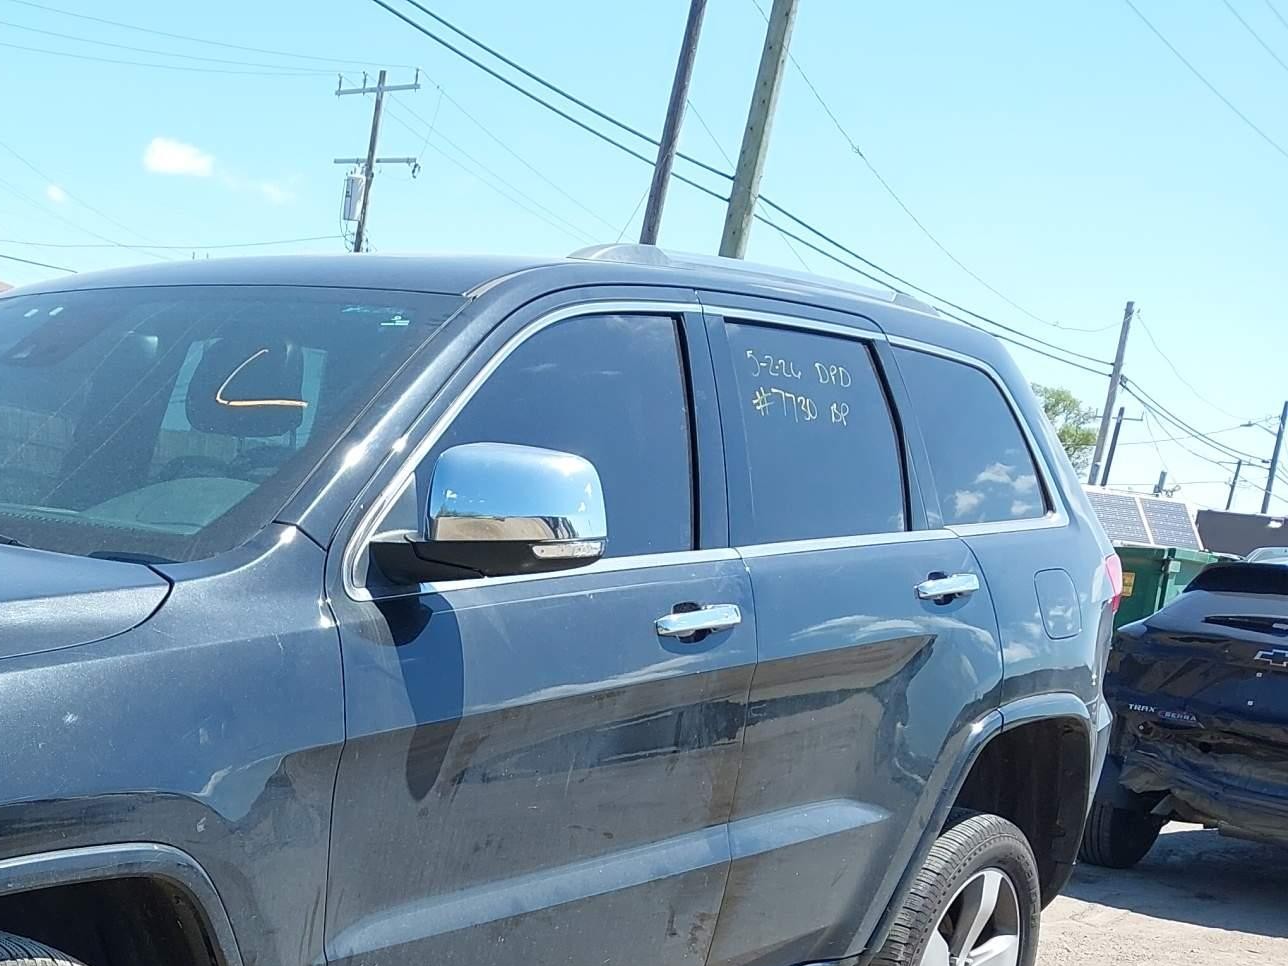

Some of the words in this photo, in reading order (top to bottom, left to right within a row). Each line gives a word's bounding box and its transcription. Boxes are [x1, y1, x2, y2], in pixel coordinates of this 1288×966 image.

[815, 362, 851, 388] DPD
[752, 386, 818, 423] #7730
[831, 403, 850, 426] BP
[1128, 703, 1157, 713] TRAX
